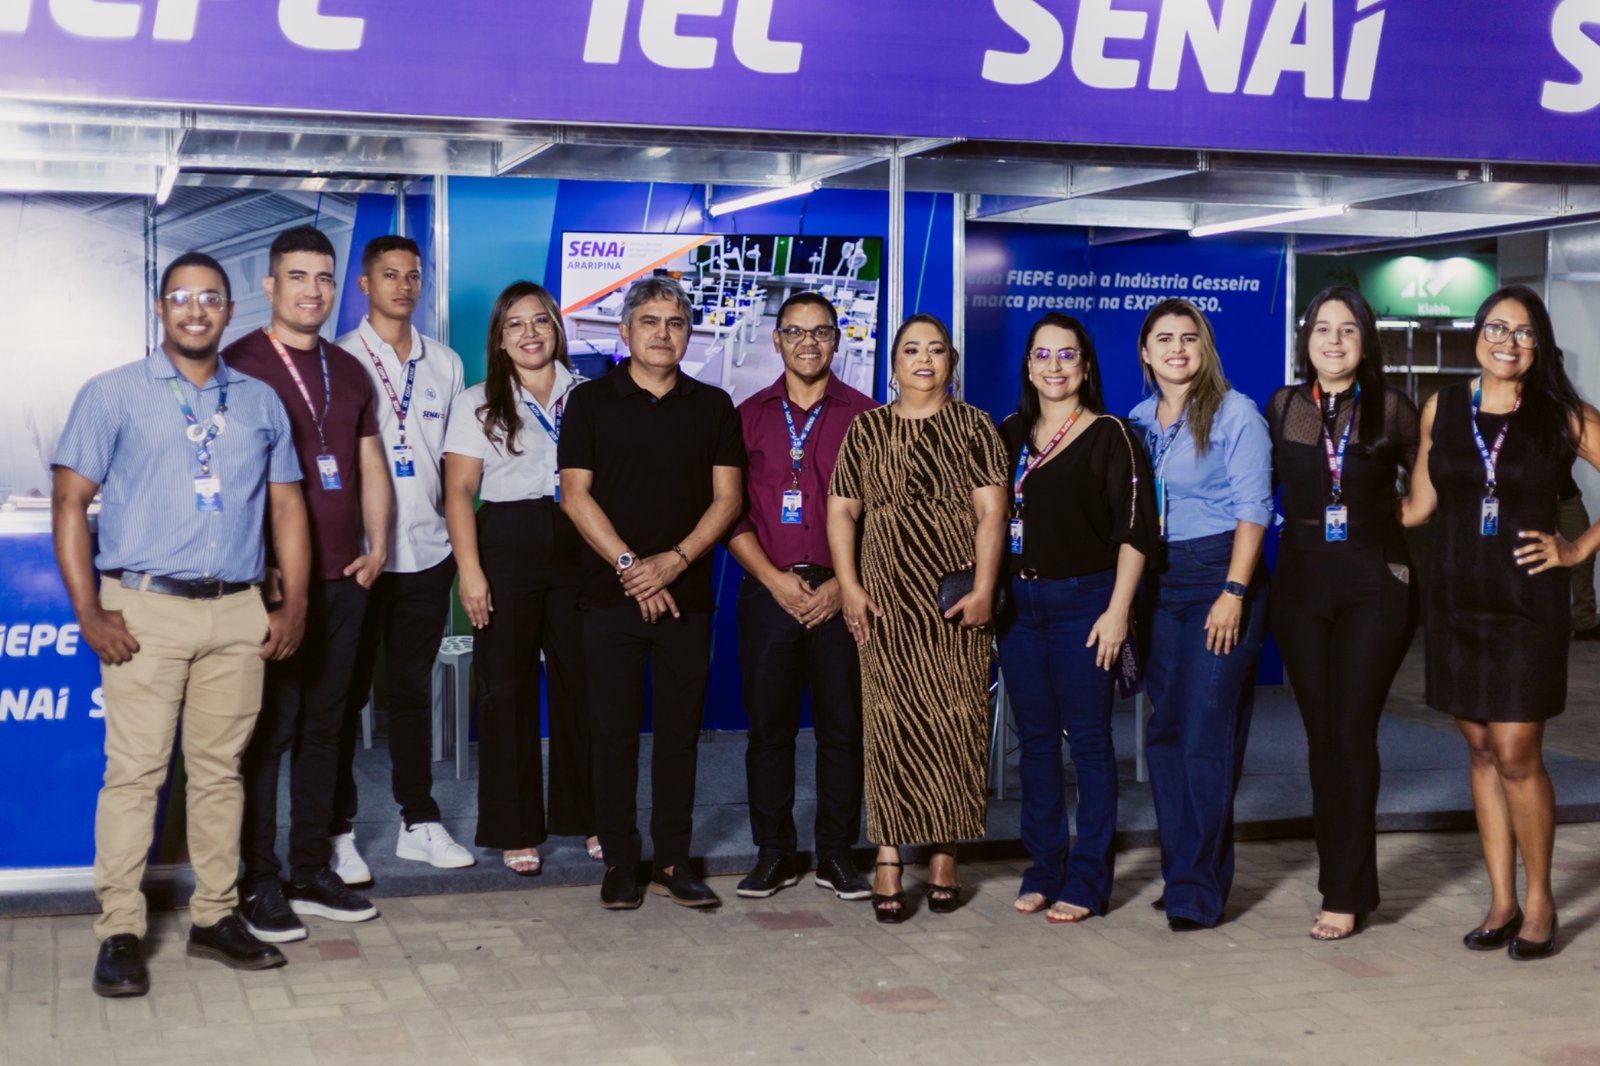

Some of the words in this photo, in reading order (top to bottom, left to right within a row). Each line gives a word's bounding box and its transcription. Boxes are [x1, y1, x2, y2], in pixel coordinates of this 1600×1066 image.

[567, 261, 622, 270] ARARIPINA
[1006, 269, 1054, 286] FIEPE
[1057, 271, 1097, 290] apoi
[1100, 275, 1111, 287] a
[1114, 272, 1188, 290] Indústria
[1192, 274, 1260, 291] Gesseira
[1027, 295, 1095, 312] presenç
[1099, 296, 1120, 310] na
